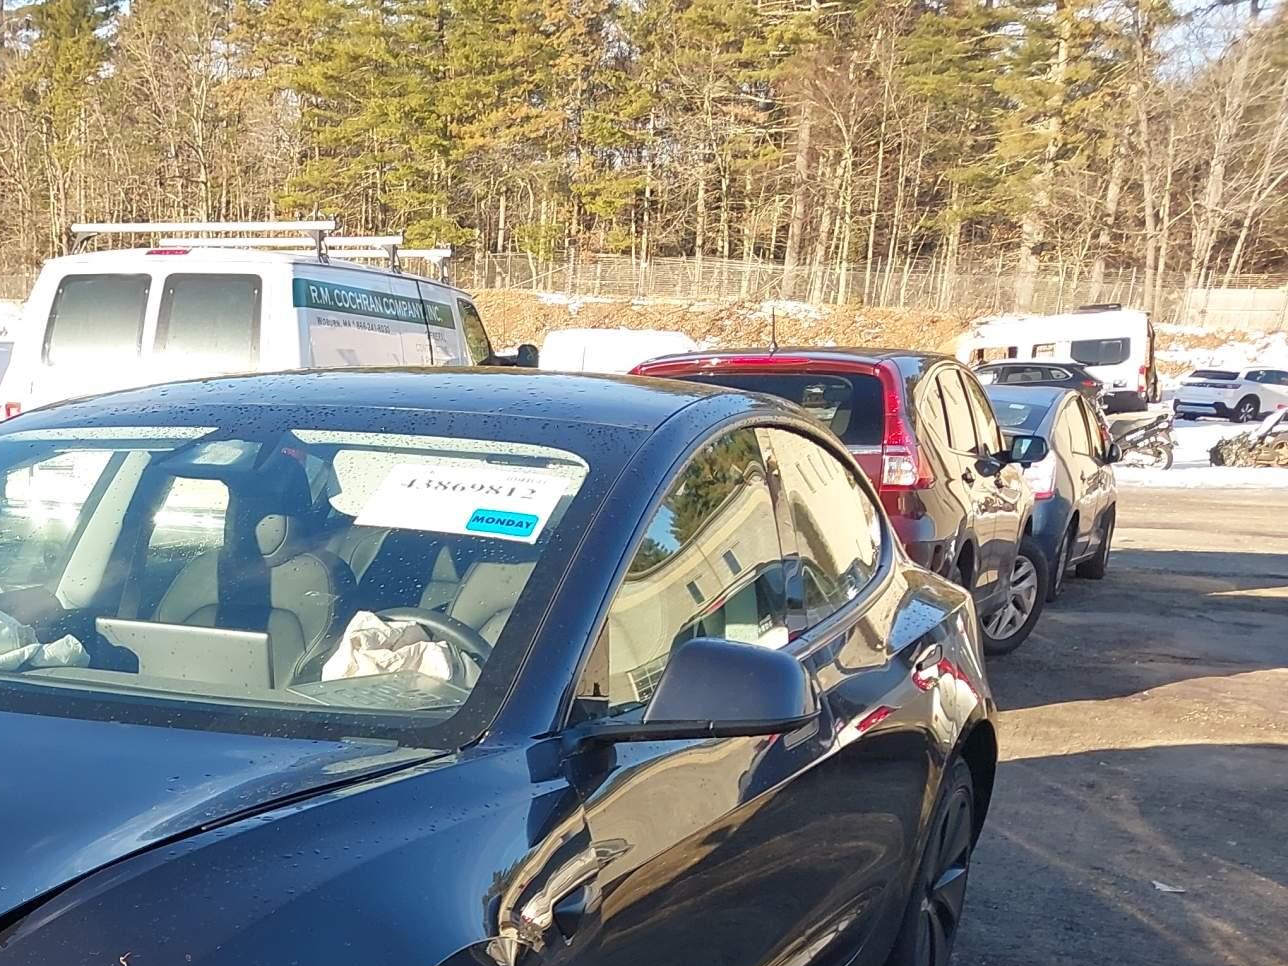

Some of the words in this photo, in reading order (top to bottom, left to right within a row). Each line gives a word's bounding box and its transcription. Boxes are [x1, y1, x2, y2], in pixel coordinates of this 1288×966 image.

[309, 285, 333, 306] R.M.
[334, 289, 383, 314] COCHRAN
[400, 478, 536, 499] 43869812
[471, 514, 534, 530] MONDAY
